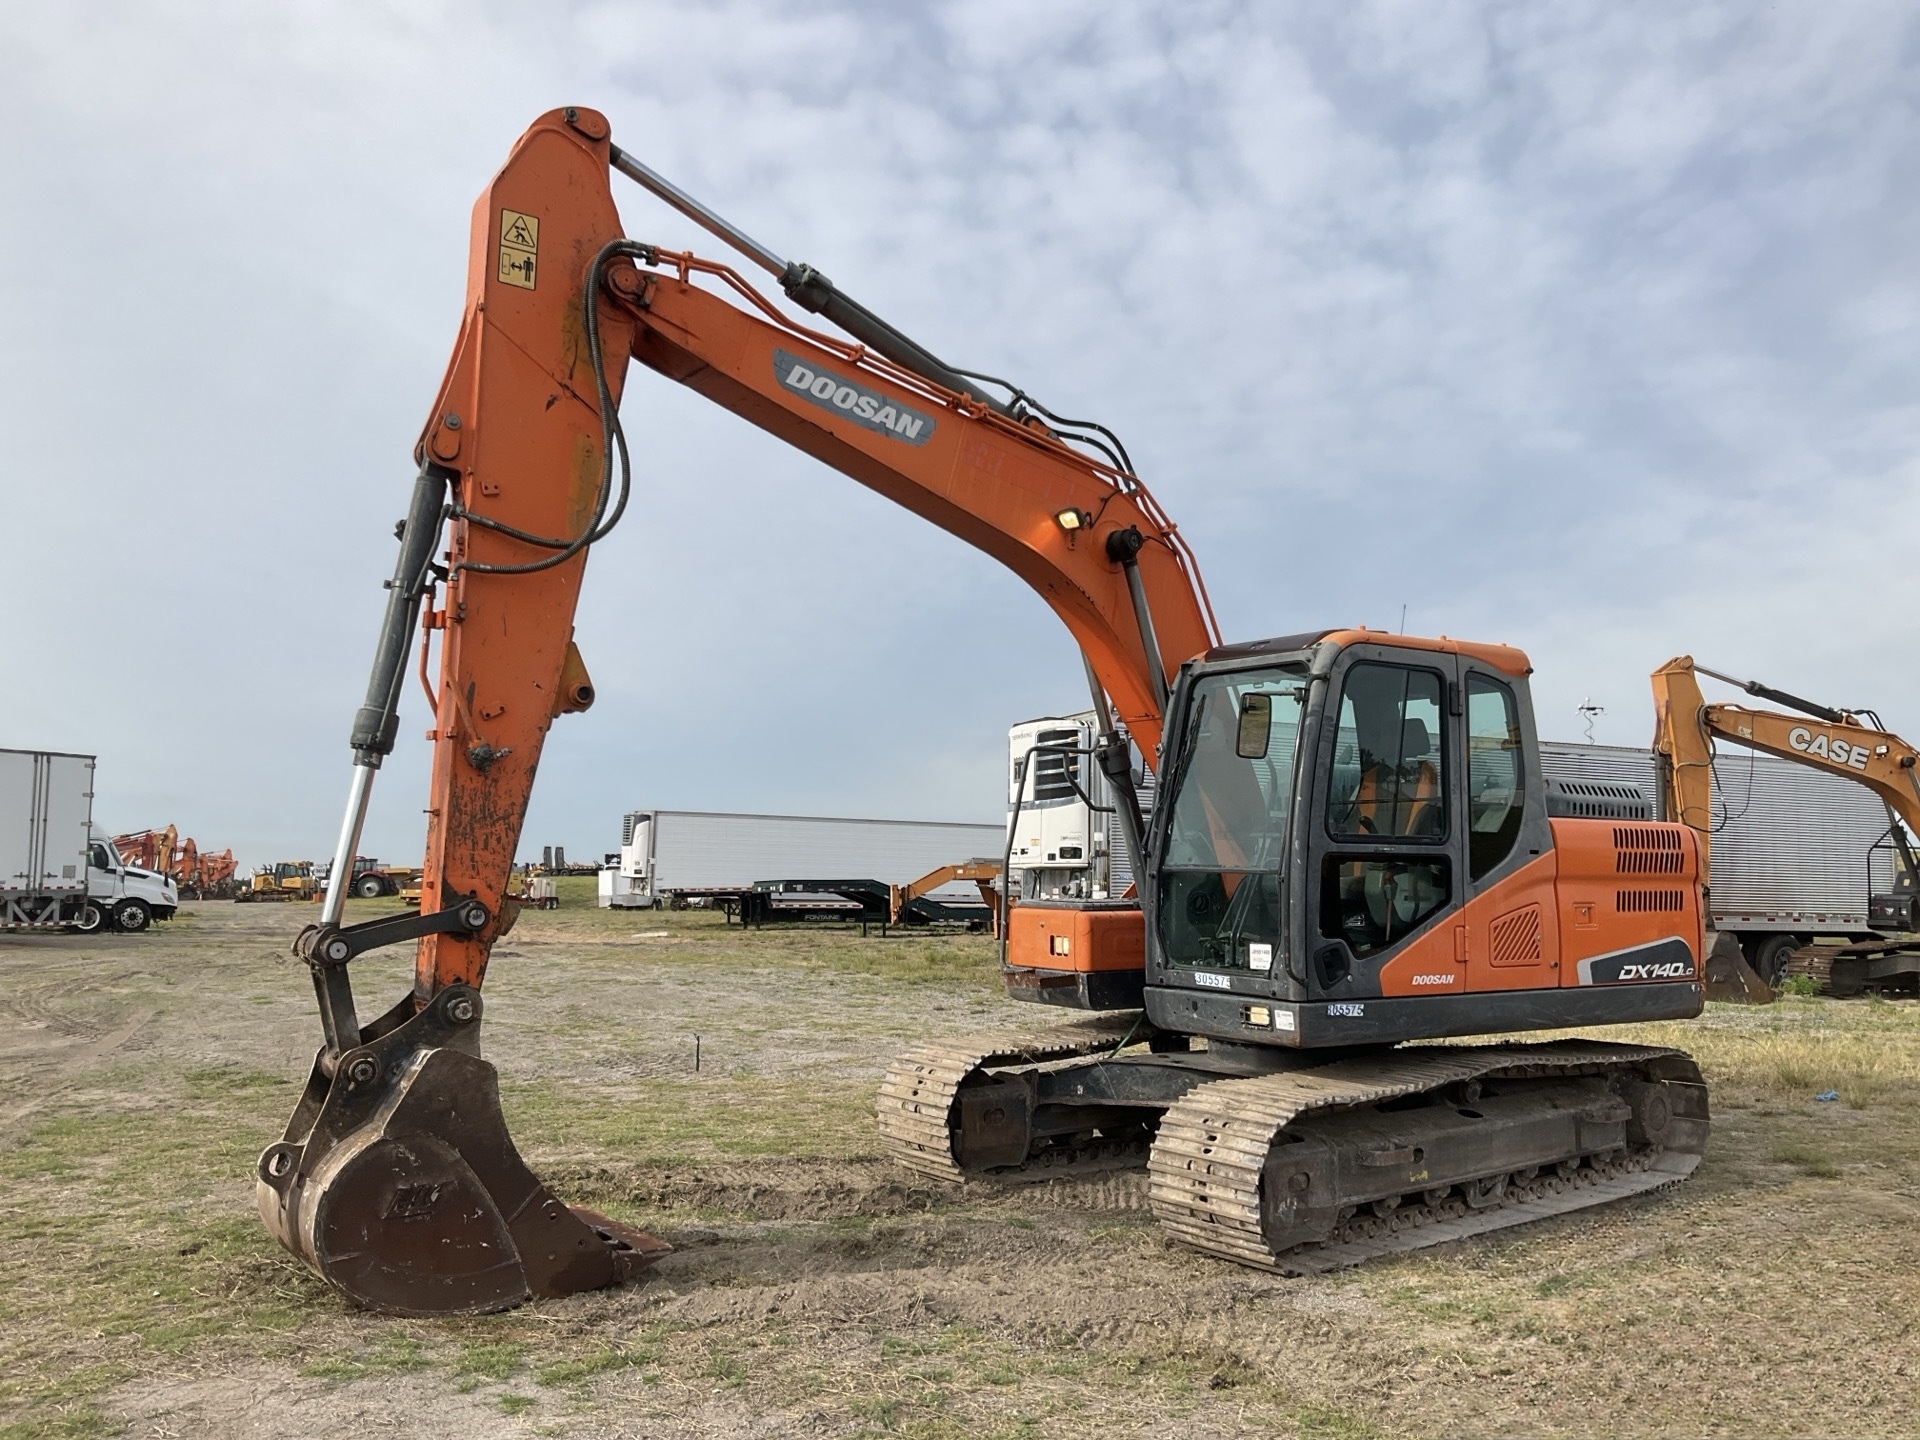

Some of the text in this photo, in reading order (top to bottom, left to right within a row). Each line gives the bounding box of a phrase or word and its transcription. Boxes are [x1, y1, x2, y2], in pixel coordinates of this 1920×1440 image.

[786, 365, 923, 438] DOOSAN
[1789, 727, 1870, 770] CASE
[1412, 974, 1454, 985] DOOSAN
